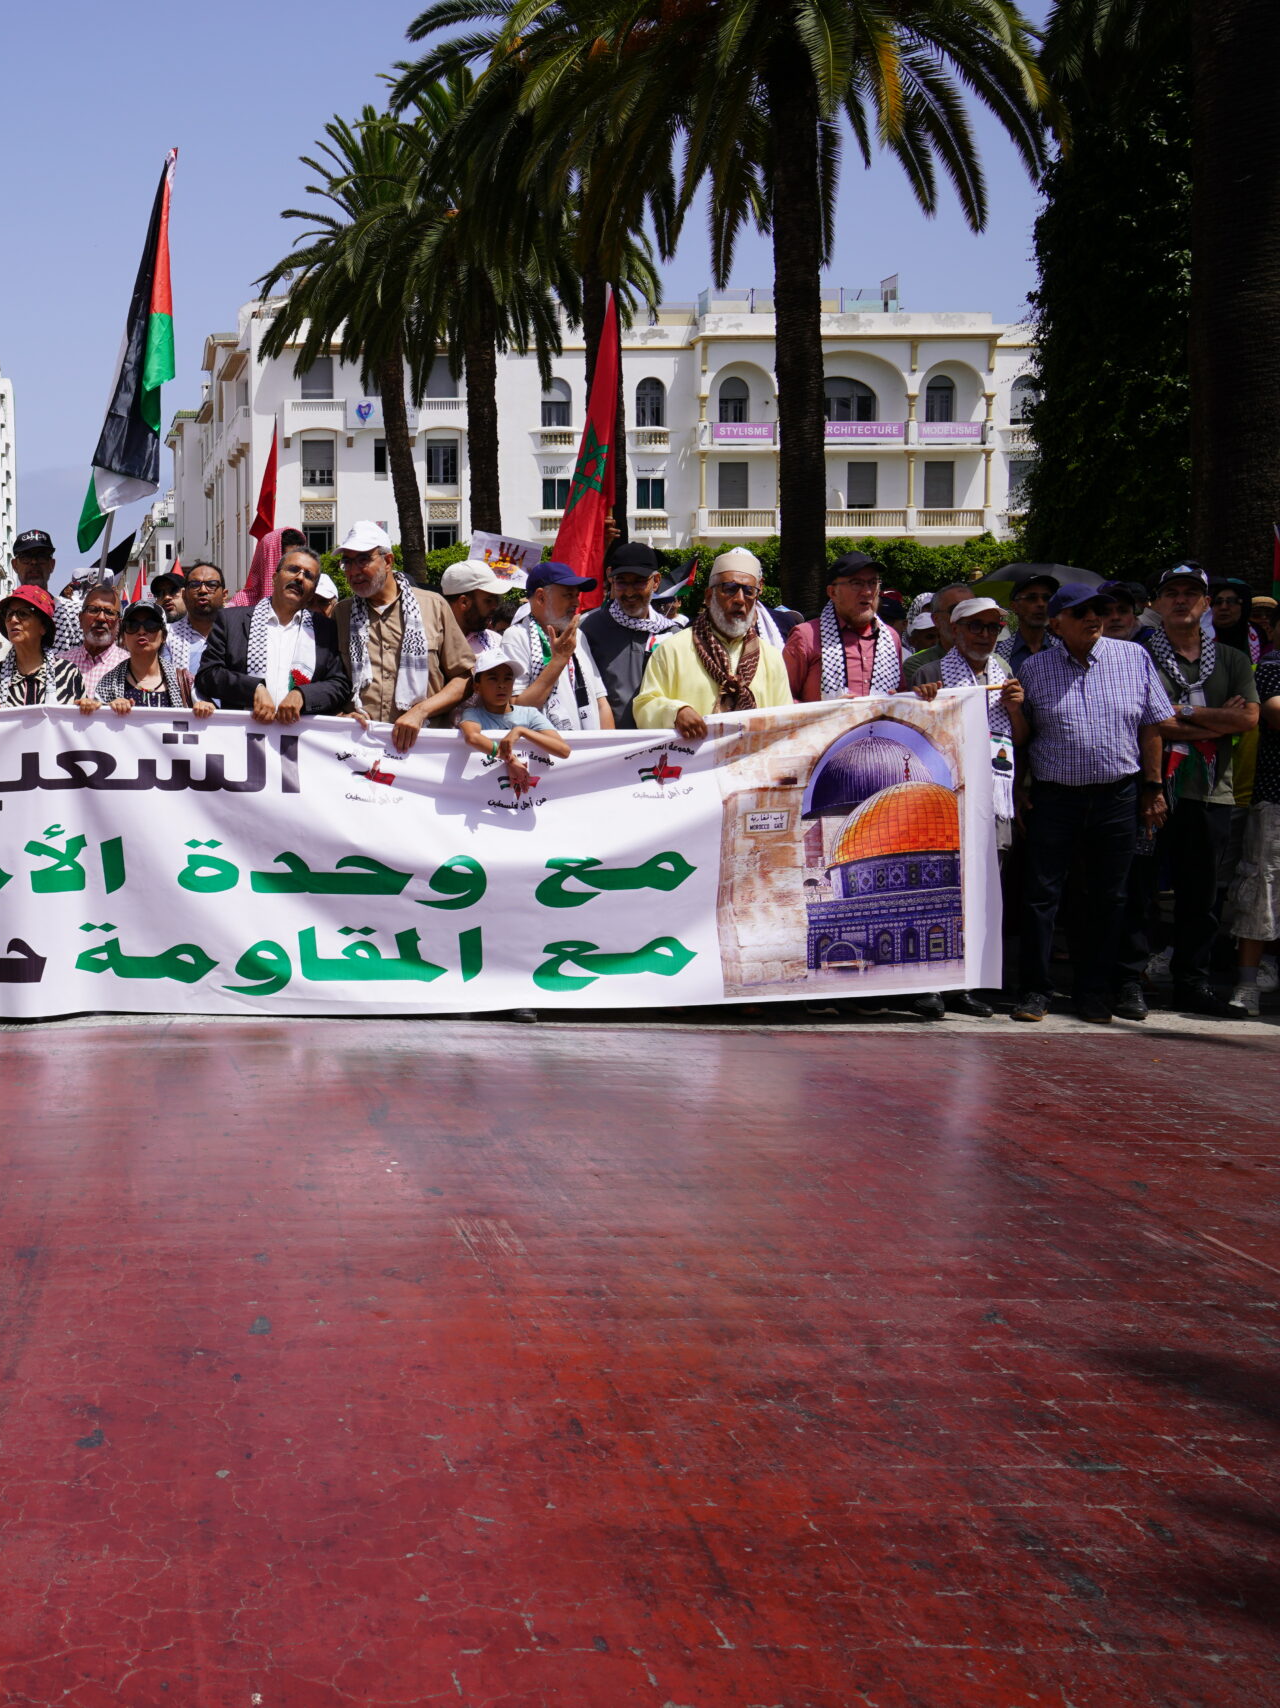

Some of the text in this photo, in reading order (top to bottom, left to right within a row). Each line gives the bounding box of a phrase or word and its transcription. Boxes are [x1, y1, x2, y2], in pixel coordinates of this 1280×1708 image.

[719, 427, 768, 436] STYLISME
[826, 425, 899, 435] RCHITECTURE
[536, 797, 547, 806] من
[177, 839, 487, 910] وحدة
[535, 851, 698, 908] مع
[75, 922, 483, 996] المقاومة
[532, 936, 698, 992] مع
